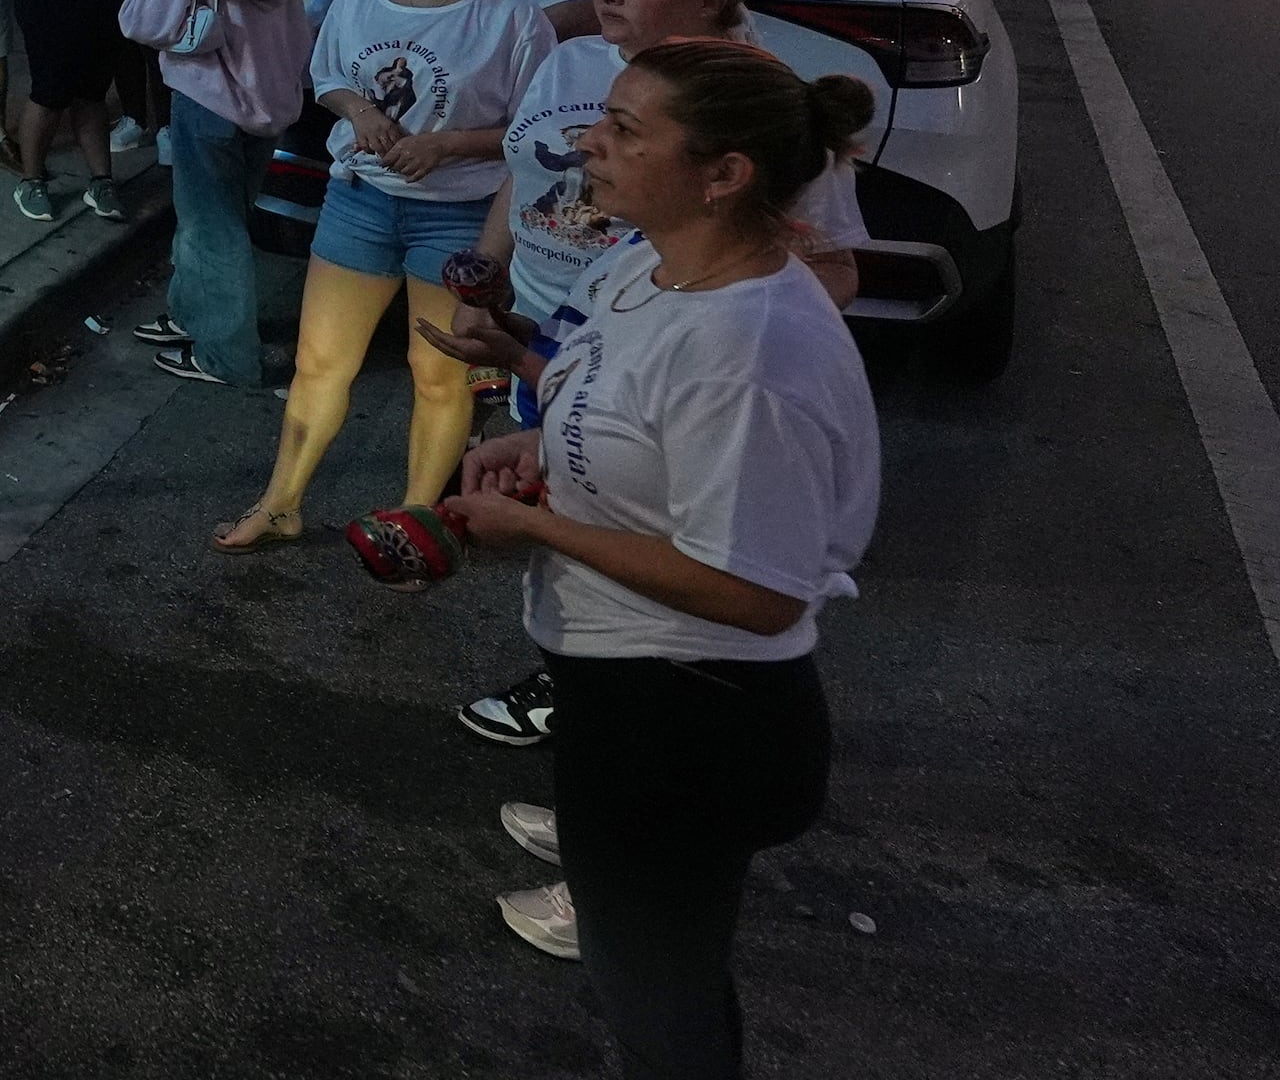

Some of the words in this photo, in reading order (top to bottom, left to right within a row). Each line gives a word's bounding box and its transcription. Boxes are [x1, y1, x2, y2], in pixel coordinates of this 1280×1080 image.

[358, 39, 401, 61] causa
[558, 102, 607, 113] caus
[522, 238, 582, 268] concepción
